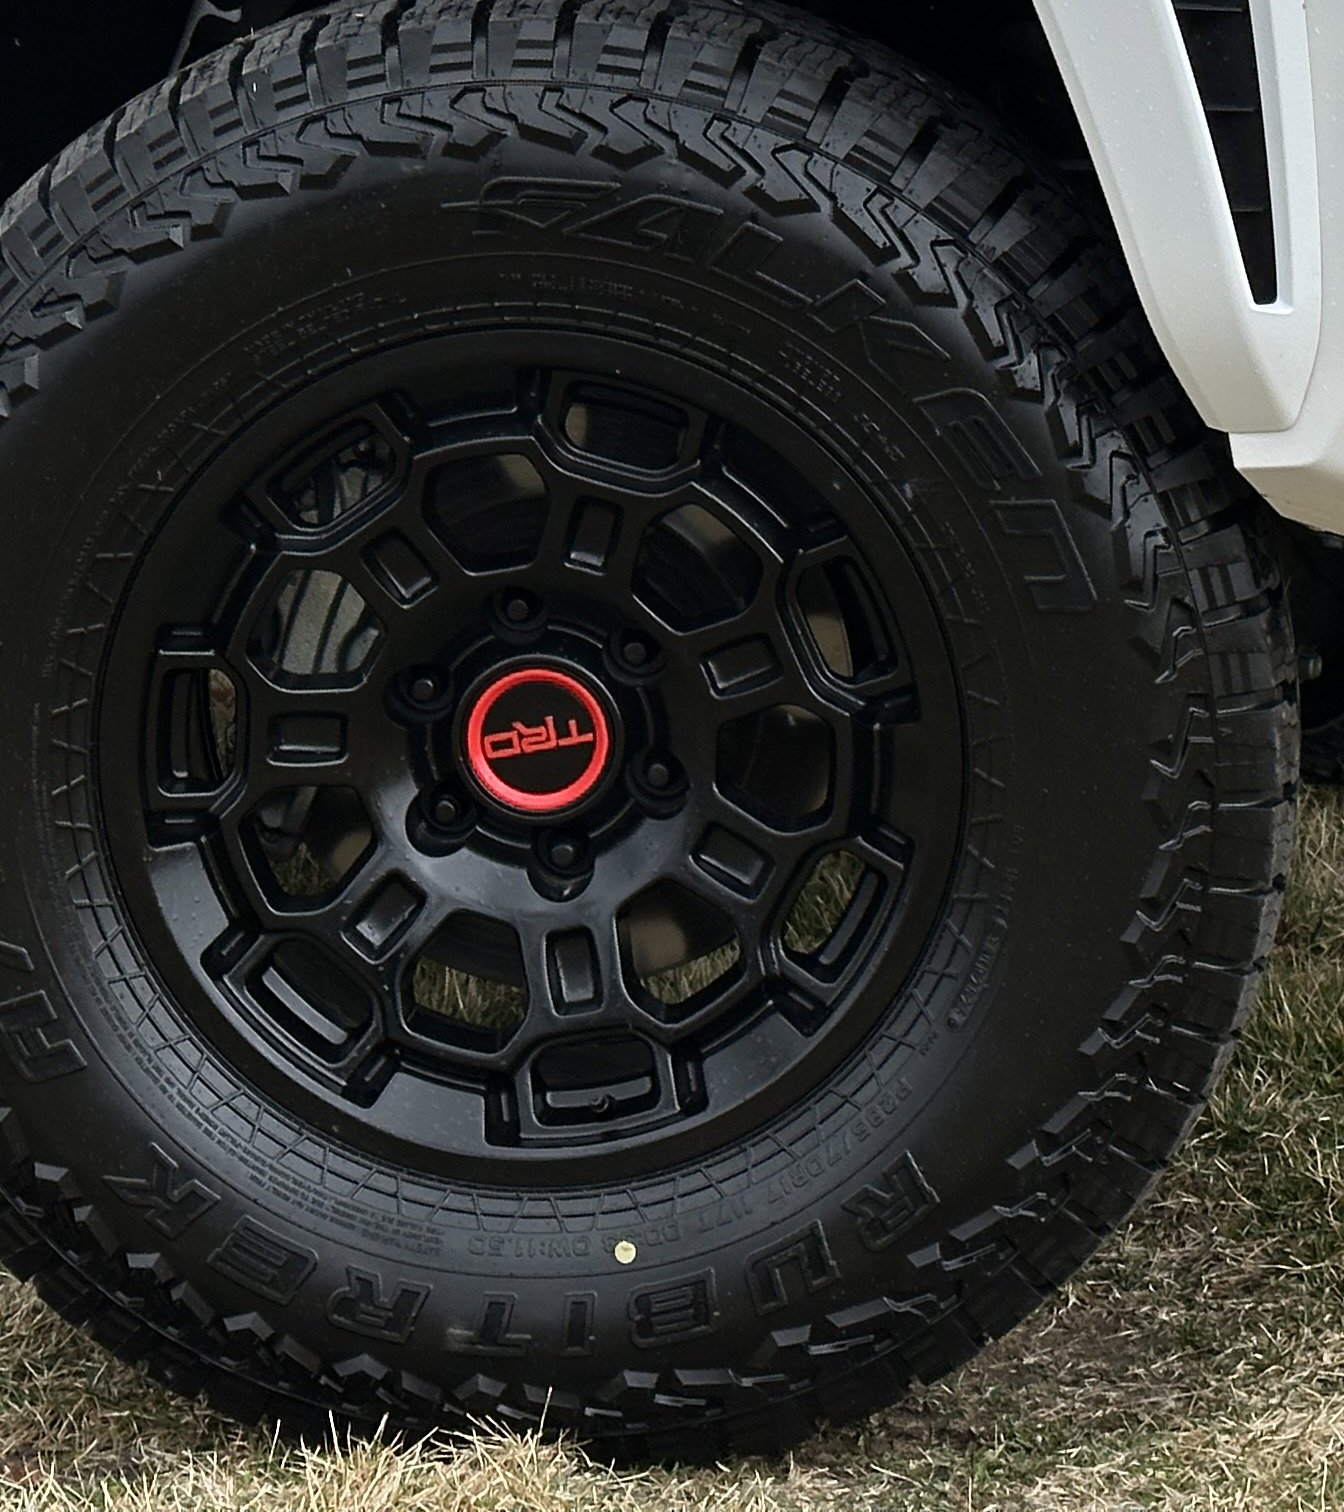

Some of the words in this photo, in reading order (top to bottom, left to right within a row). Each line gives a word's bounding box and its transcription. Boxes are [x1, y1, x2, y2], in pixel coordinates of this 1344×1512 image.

[439, 176, 1094, 614] FALKEN
[483, 715, 594, 760] TRD
[104, 1141, 943, 1356] RUBITREK
